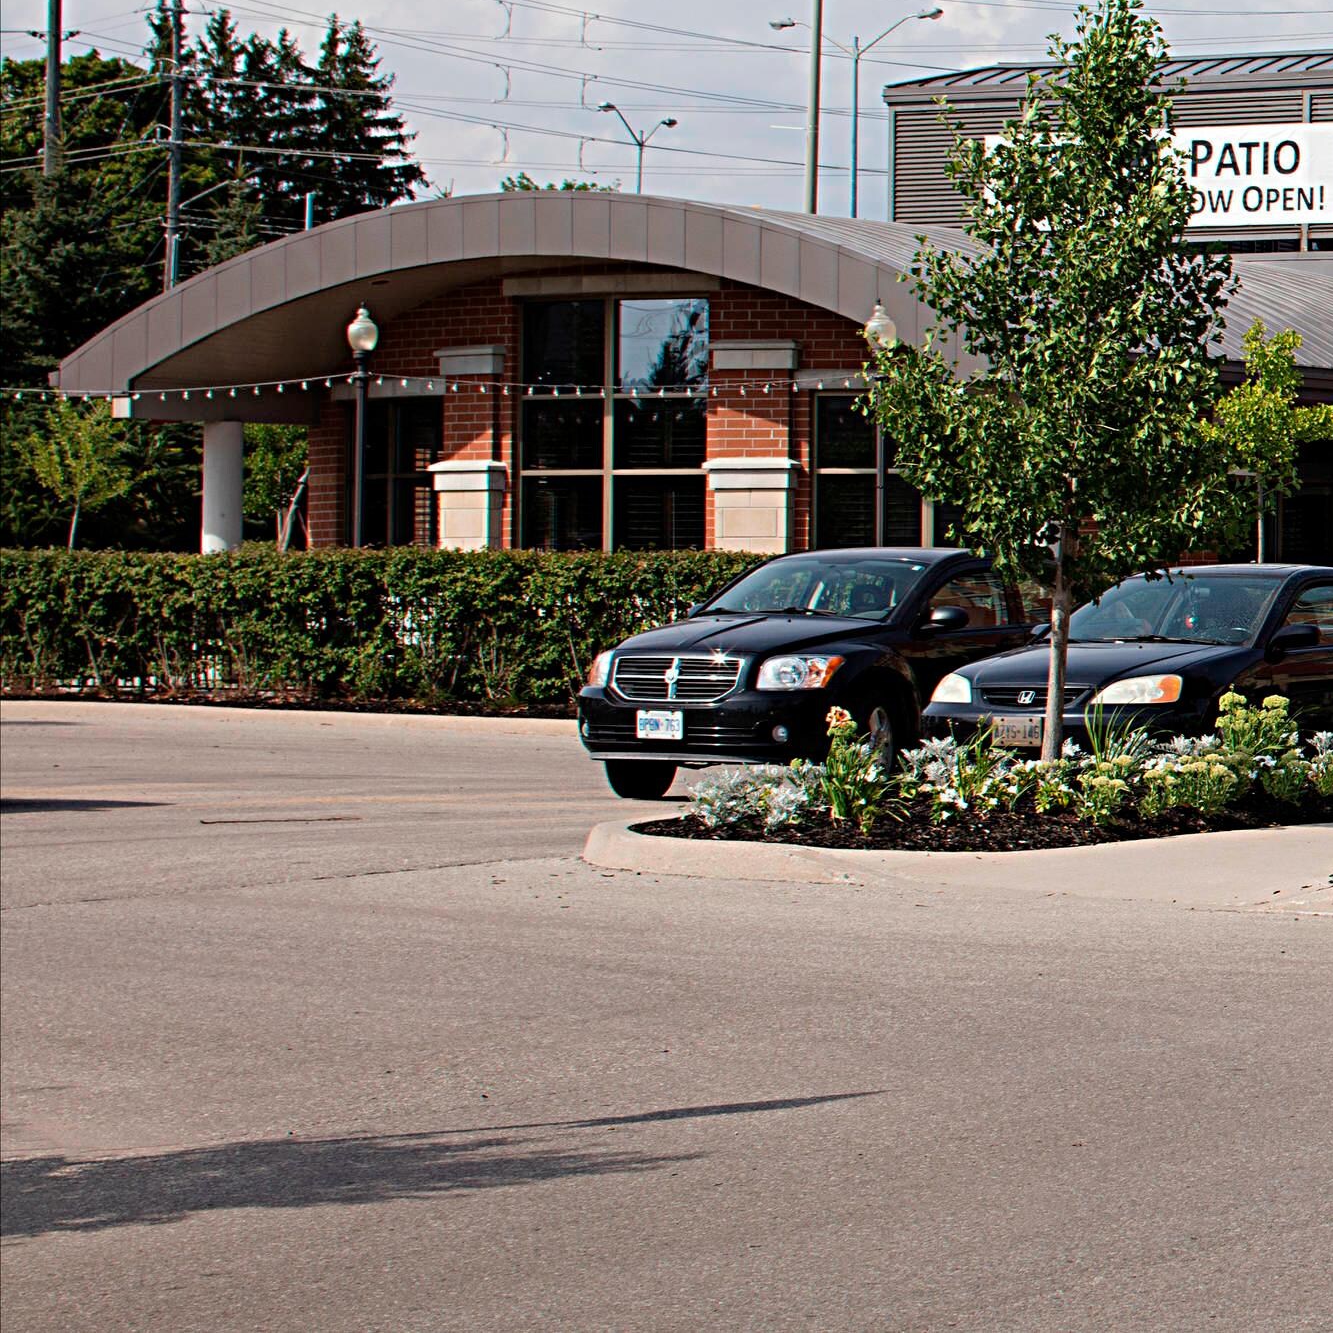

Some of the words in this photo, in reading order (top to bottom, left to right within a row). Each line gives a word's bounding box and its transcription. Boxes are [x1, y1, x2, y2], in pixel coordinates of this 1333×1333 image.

[1190, 139, 1301, 177] PATIO
[1192, 189, 1234, 214] OW
[1242, 185, 1324, 212] OPEN!
